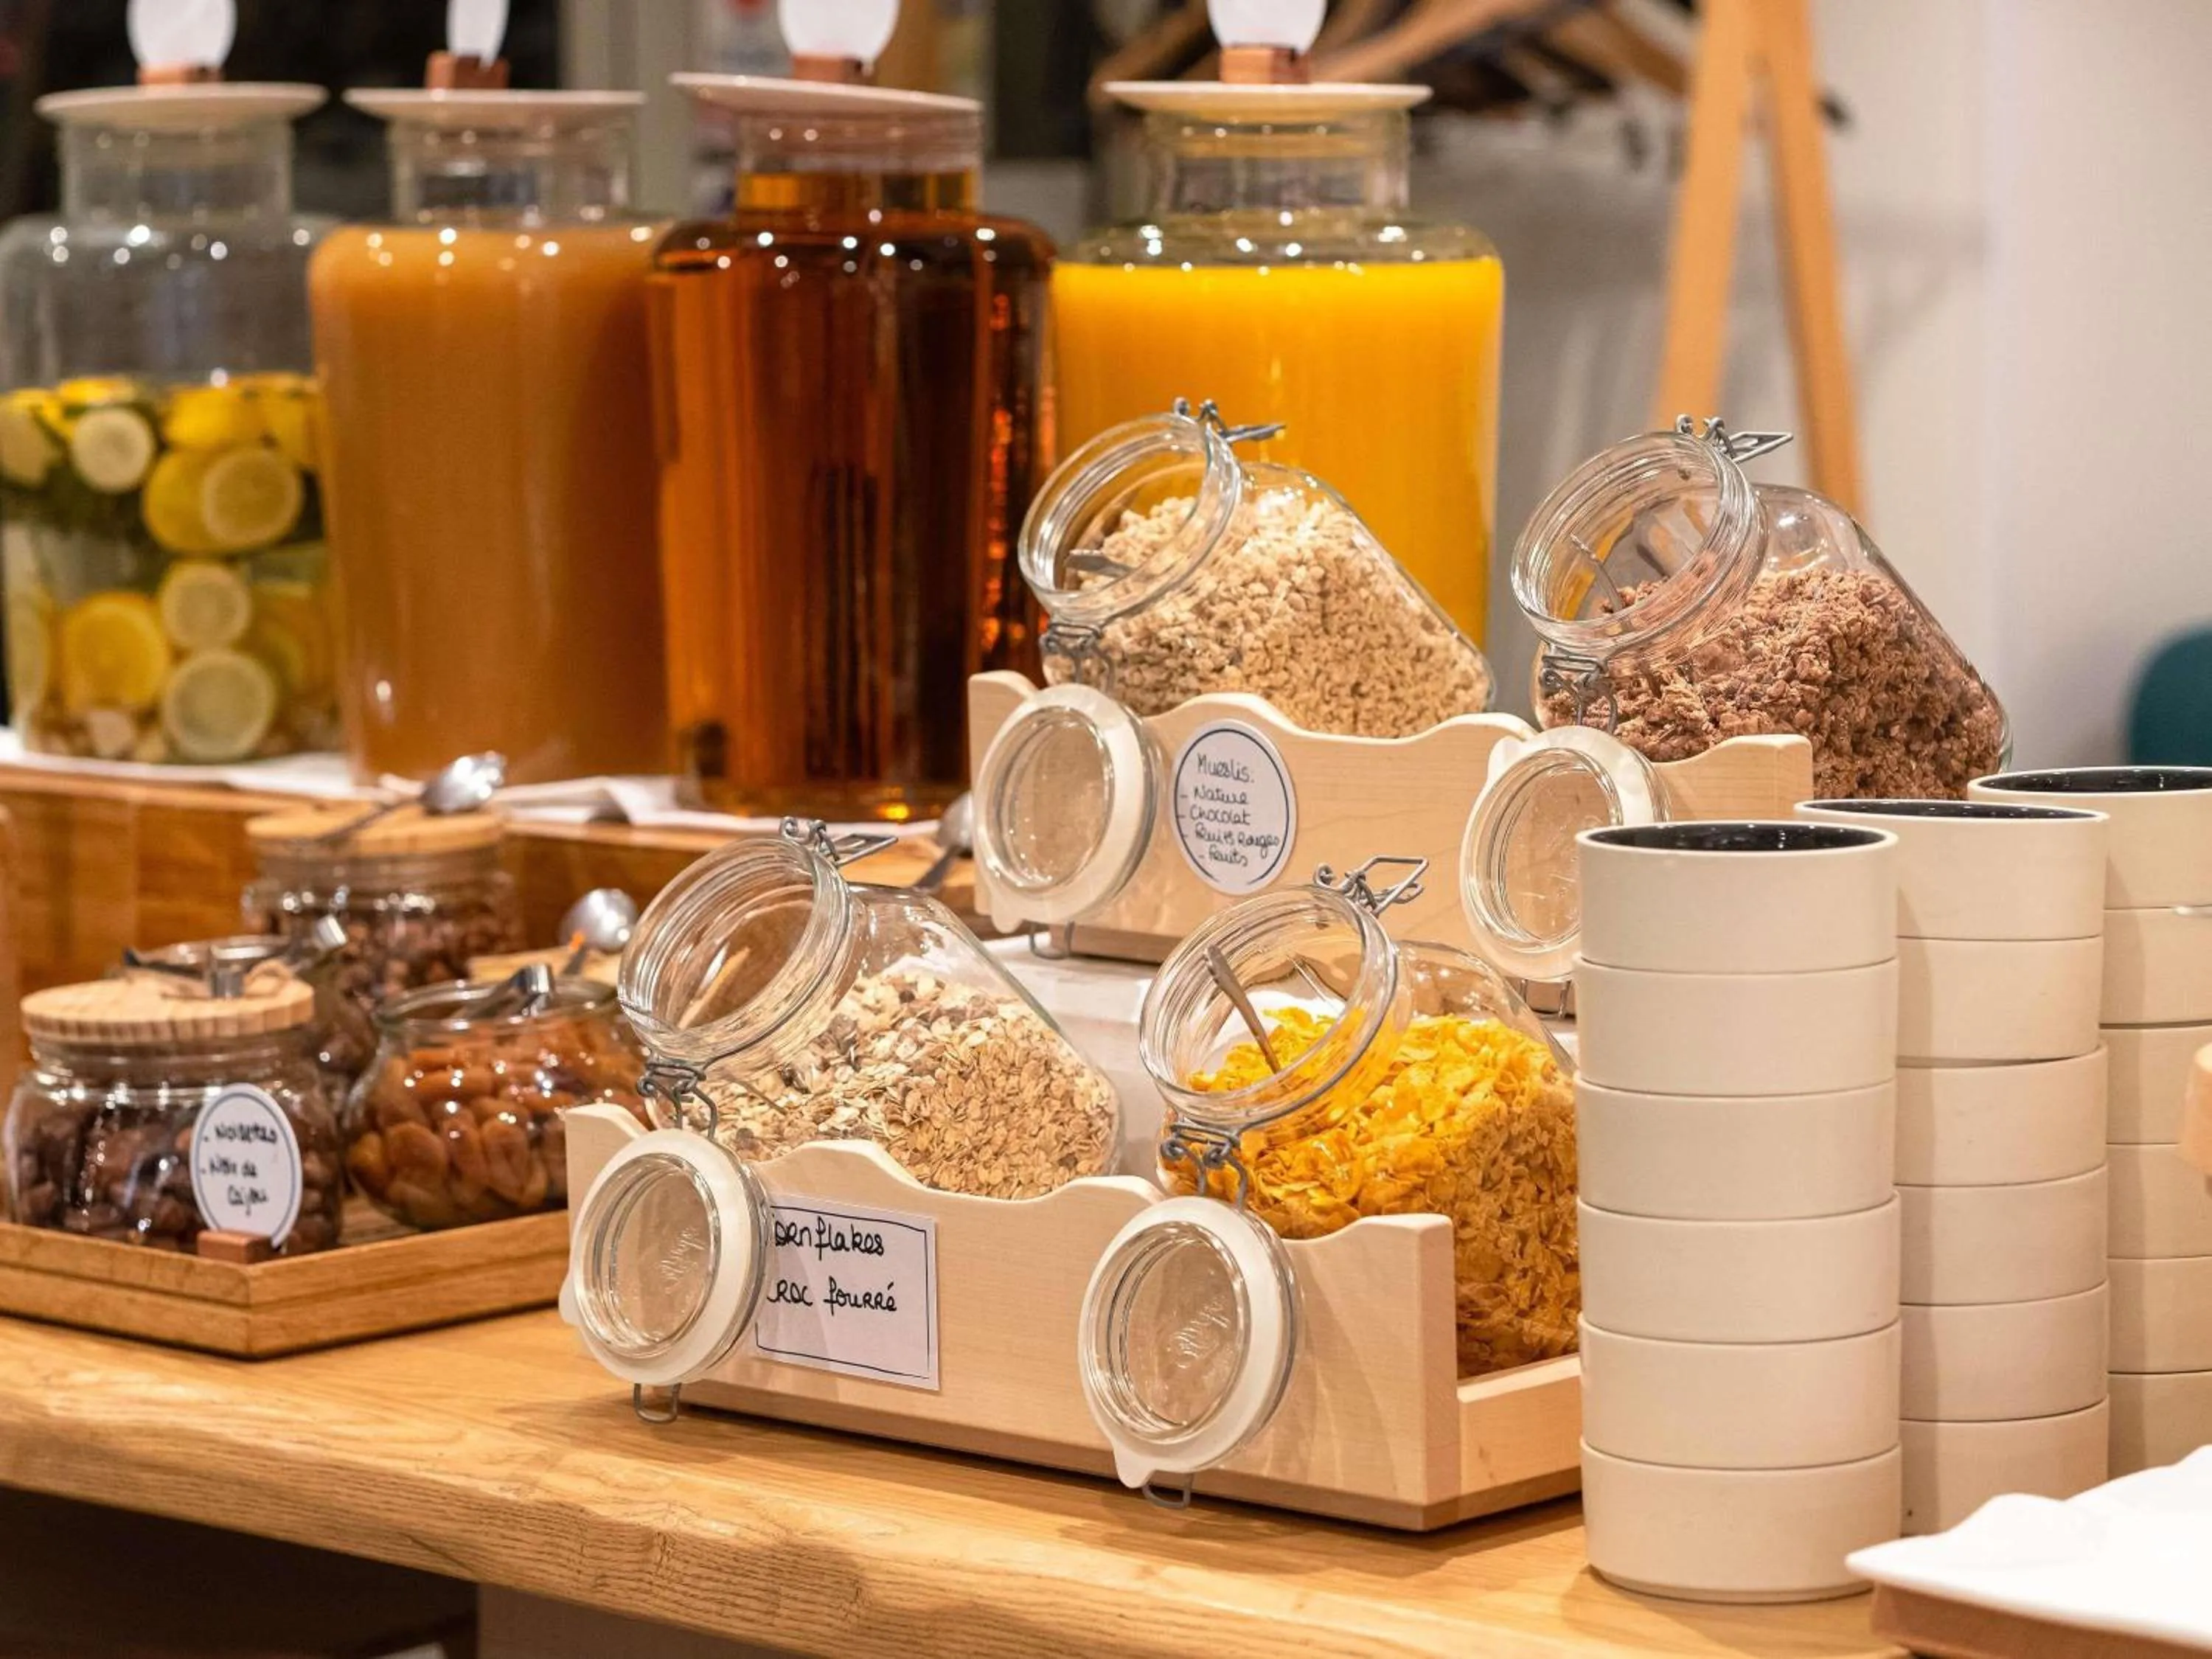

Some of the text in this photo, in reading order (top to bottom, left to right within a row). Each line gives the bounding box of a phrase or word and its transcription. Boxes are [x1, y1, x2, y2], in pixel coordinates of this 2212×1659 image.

[1193, 785, 1250, 804] Nature
[1190, 804, 1251, 826] Chocolat
[773, 1216, 884, 1262] ornflakes
[767, 1275, 897, 1316] roc fourré
